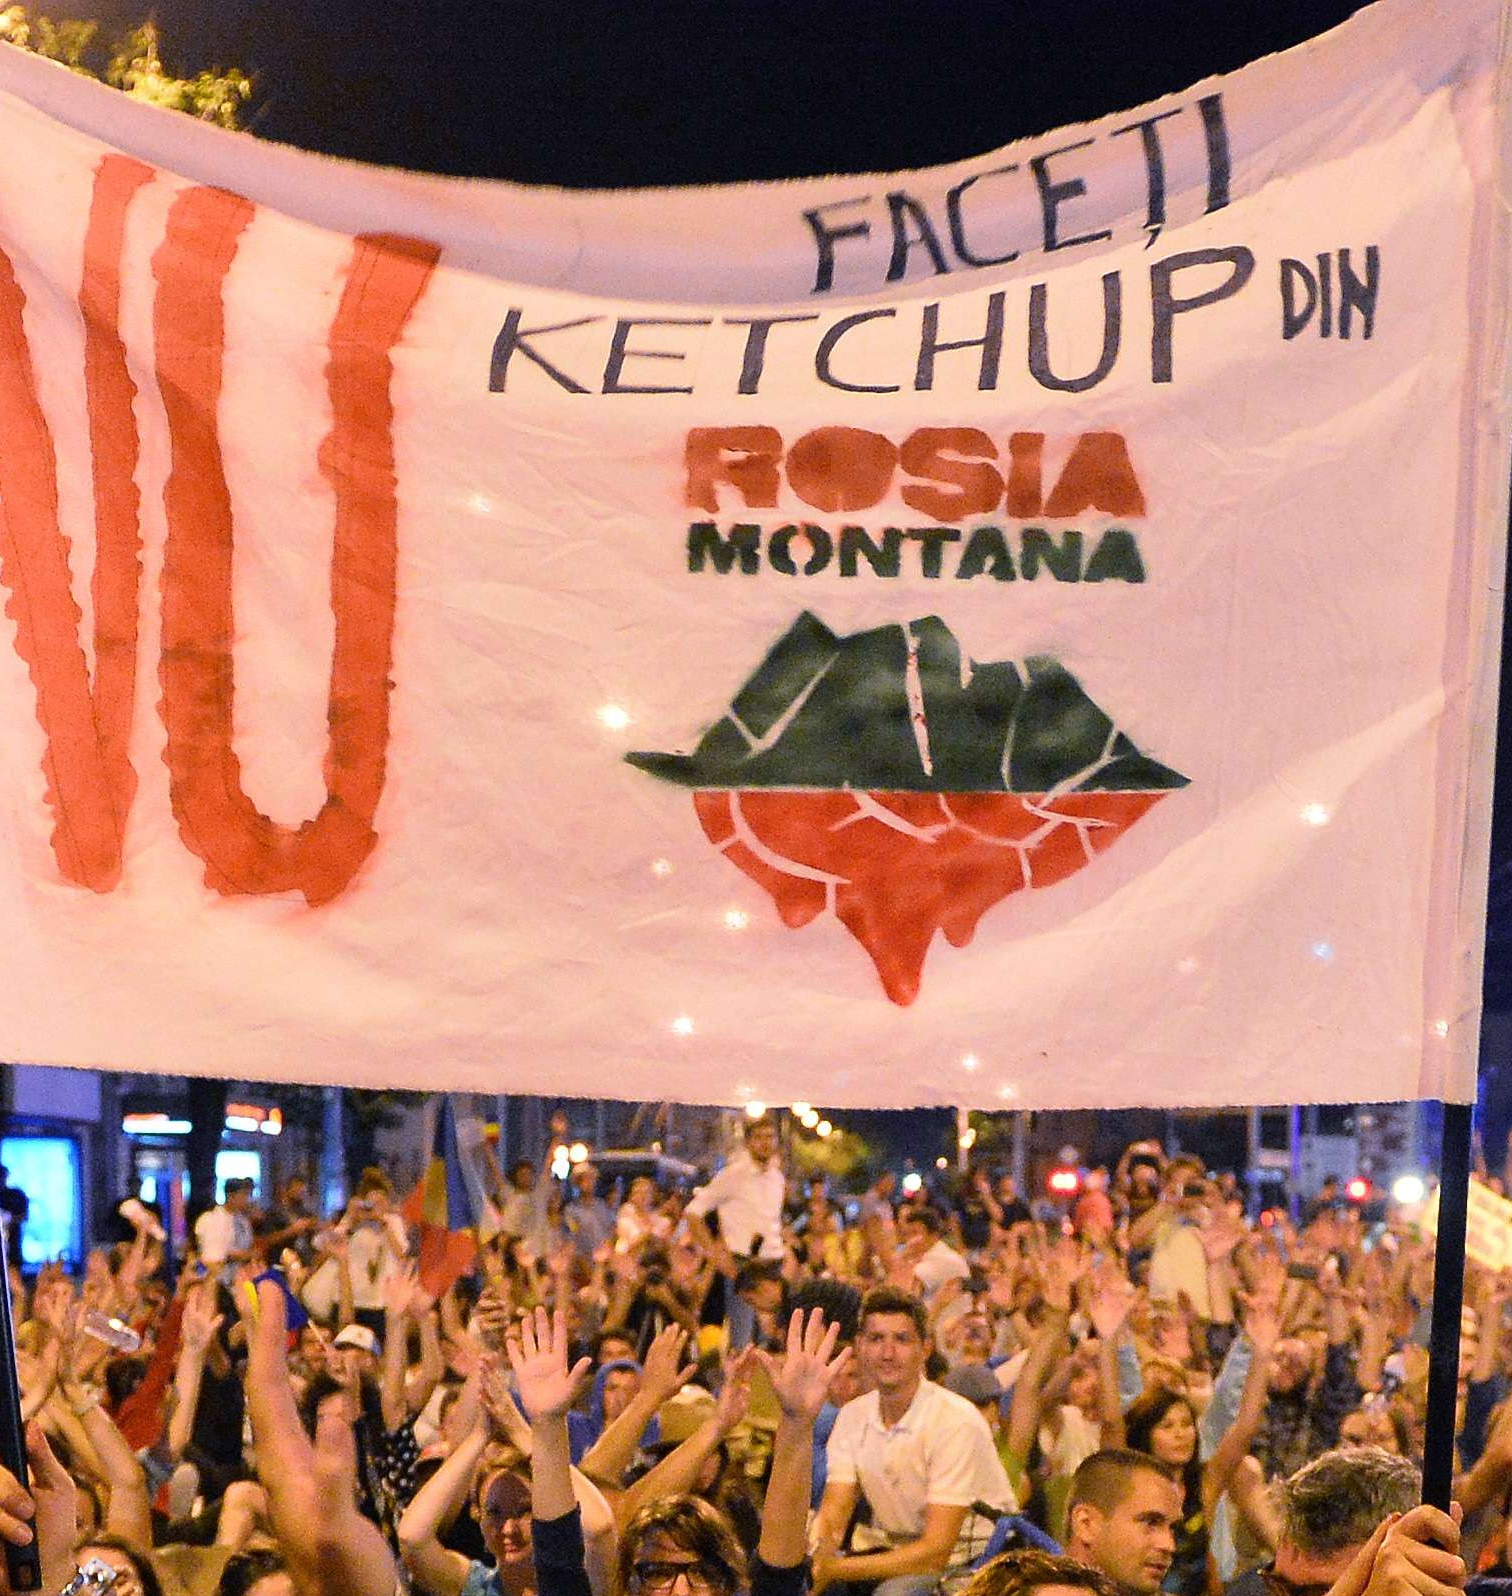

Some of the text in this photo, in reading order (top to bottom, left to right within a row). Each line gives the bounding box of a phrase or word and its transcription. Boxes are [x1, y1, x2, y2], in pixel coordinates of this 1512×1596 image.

[488, 244, 1381, 395] KETCHUP DIN
[684, 425, 1147, 522] ROSIA
[687, 522, 1147, 583] MONTANA
